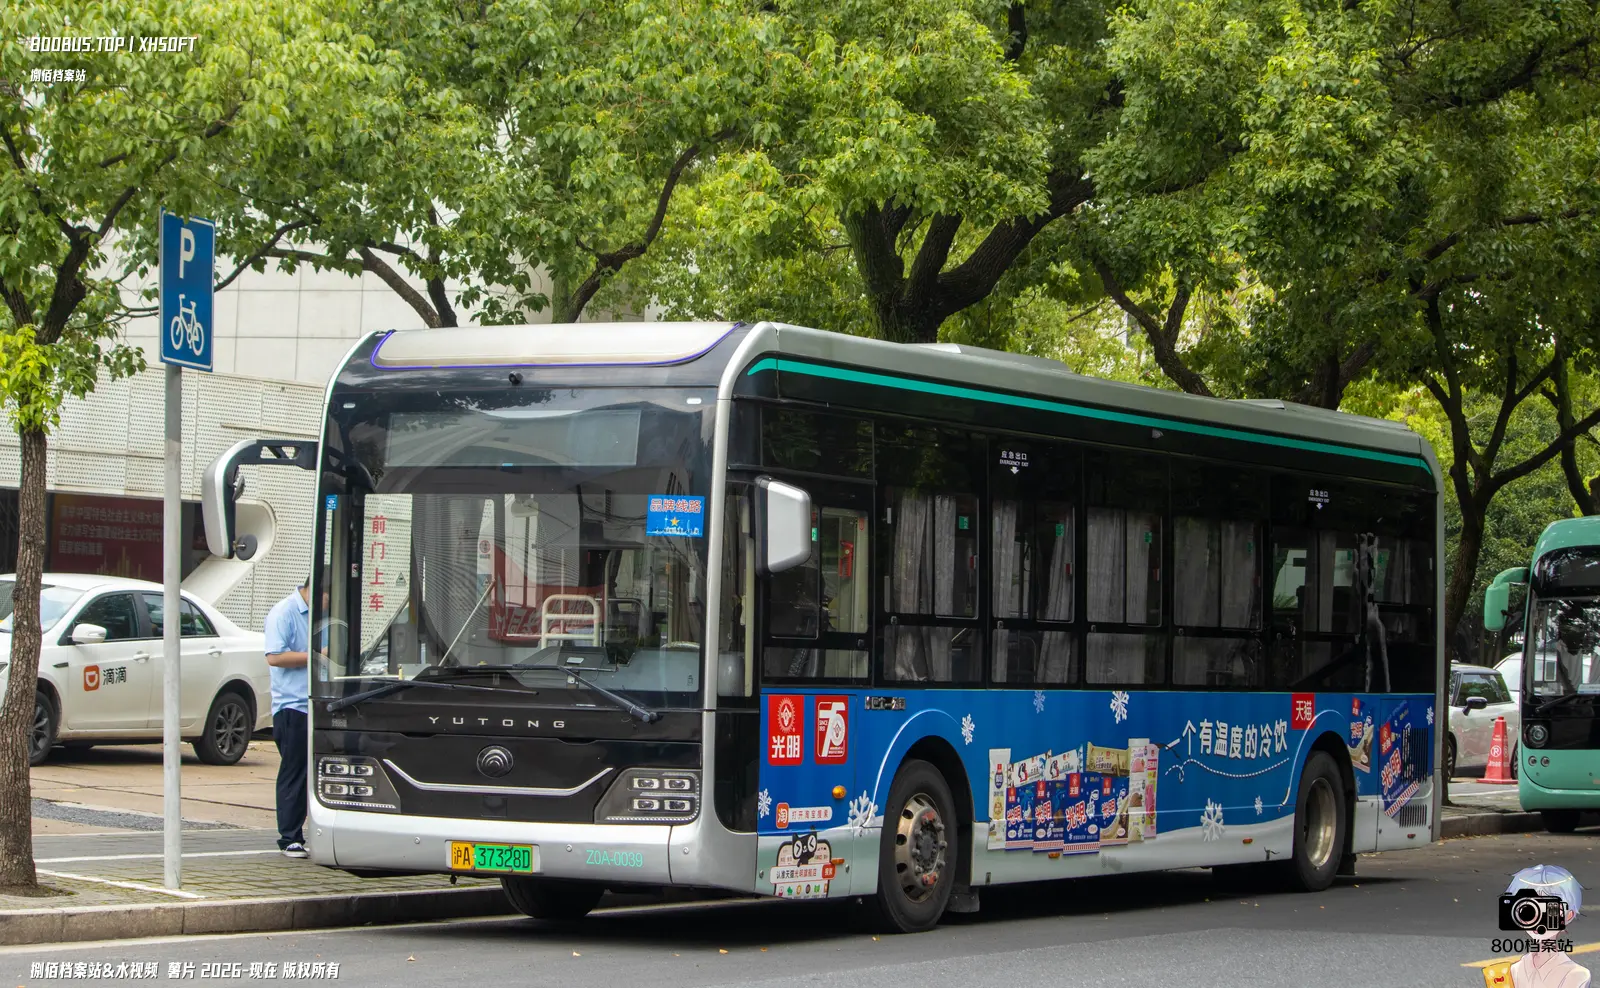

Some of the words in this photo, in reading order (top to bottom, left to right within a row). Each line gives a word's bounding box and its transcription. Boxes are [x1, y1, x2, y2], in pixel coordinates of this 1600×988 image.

[179, 227, 195, 279] P
[650, 498, 702, 513] 品牌线路
[369, 515, 387, 612] 前门上车
[103, 666, 127, 686] 滴滴
[1295, 700, 1313, 721] 天猫
[428, 716, 567, 729] YUTONG
[771, 735, 801, 758] 光明
[1164, 718, 1289, 759] 一个有温度的冷饮
[453, 846, 472, 866] 沪A
[477, 847, 532, 869] 37328D
